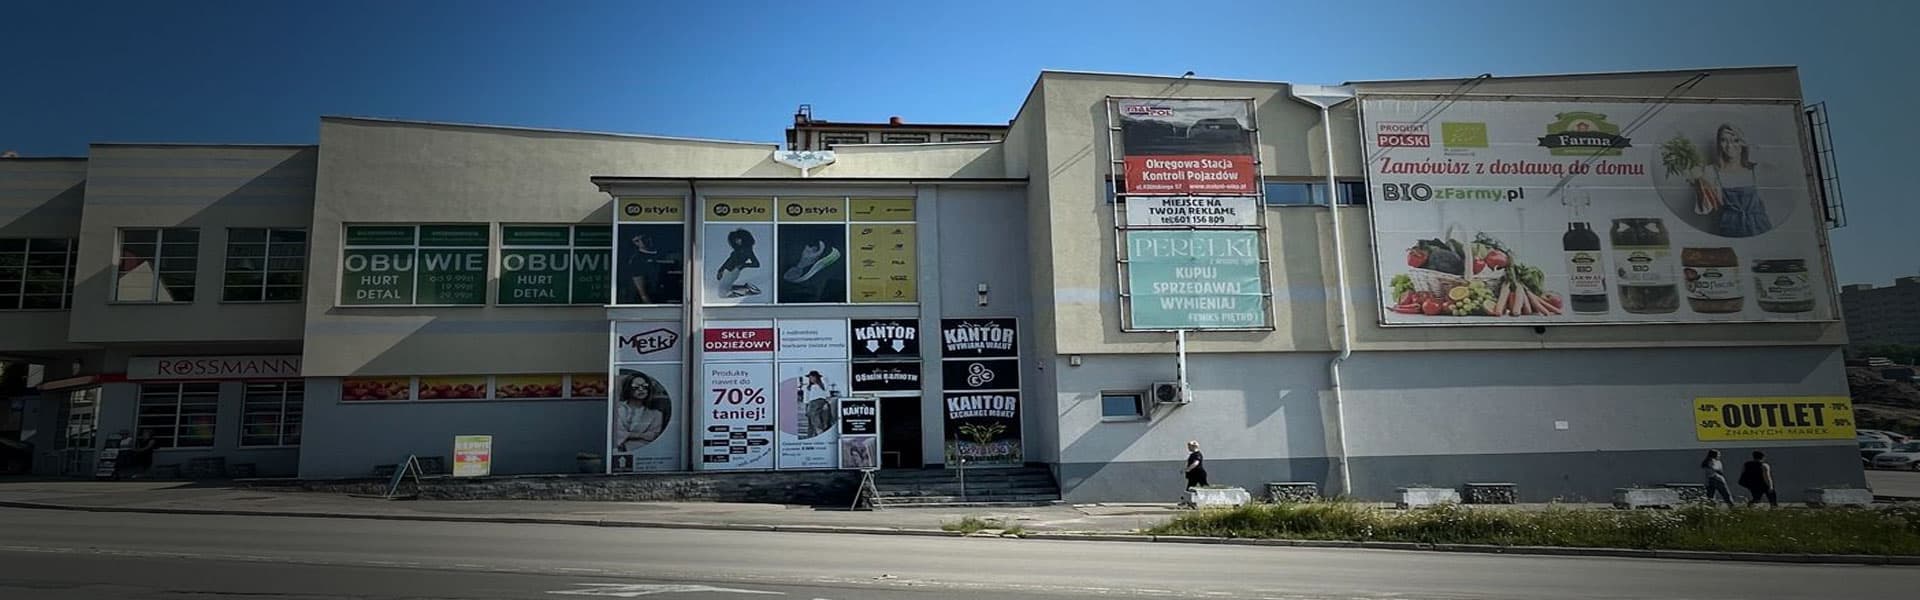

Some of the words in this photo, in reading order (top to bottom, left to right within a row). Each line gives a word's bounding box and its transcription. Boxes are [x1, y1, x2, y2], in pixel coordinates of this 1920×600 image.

[1379, 135, 1429, 146] POLSKI
[1559, 135, 1611, 146] Farma
[1146, 159, 1200, 172] Okręgowa
[1202, 159, 1233, 171] Stacja
[1379, 157, 1470, 175] Zamówisz
[1476, 162, 1485, 175] z
[1490, 159, 1564, 178] dostawą
[1568, 159, 1589, 175] do
[1596, 159, 1645, 175] domu
[1142, 172, 1185, 181] Kontroli
[1187, 171, 1238, 182] Pojazdów
[1162, 199, 1206, 207] MIEJSCE
[1207, 199, 1222, 207] NA
[644, 206, 678, 215] style
[732, 206, 765, 215] style
[804, 206, 837, 215] style
[1149, 207, 1187, 216] TWOJĄ
[1188, 207, 1236, 217] REKLAMĘ
[503, 253, 609, 272] OBUWI
[1176, 267, 1217, 278] KUPUJ
[361, 275, 399, 285] HURT
[518, 275, 553, 285] HURT
[513, 289, 555, 298] DETAL
[1152, 282, 1240, 294] SPRZEDAWAJ
[357, 289, 401, 299] DETAL
[1160, 297, 1236, 310] WYMIENIAJ
[721, 331, 756, 339] SKLEP
[854, 326, 916, 340] KANTOR
[943, 327, 1014, 343] KANTOR
[619, 335, 675, 348] Metki
[947, 342, 986, 351] WYMIANA
[985, 341, 1012, 350] WALUT
[158, 359, 299, 376] ROSSMANN
[712, 370, 749, 378] Produkty
[712, 388, 765, 405] 70%
[946, 395, 1017, 412] KANTOR
[712, 407, 766, 421] taniej!
[843, 406, 875, 416] KANTOR
[949, 409, 988, 419] EXCHANGE
[988, 409, 1015, 418] MONEY
[1721, 403, 1825, 428] OUTLET
